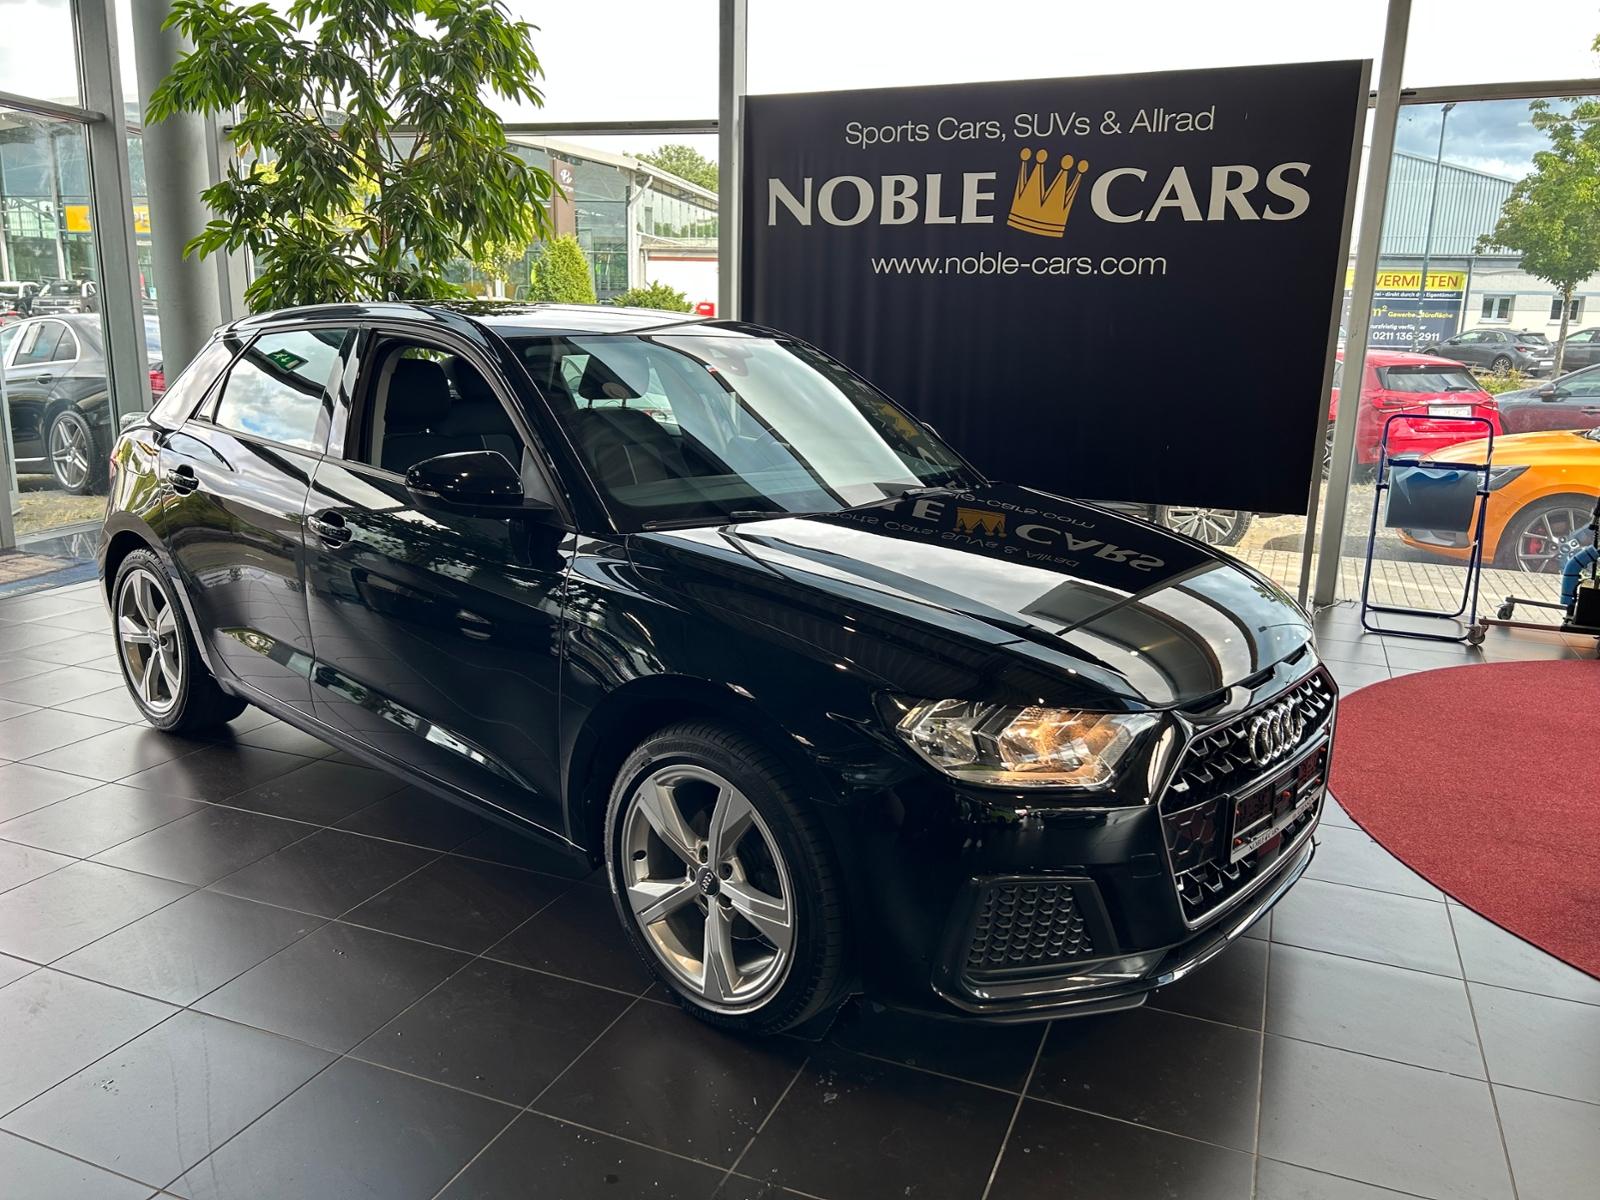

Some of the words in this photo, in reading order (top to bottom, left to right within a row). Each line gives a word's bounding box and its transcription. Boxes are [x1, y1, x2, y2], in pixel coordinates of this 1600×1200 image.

[845, 120, 930, 149] Sports
[937, 116, 1006, 142] Cars,
[1013, 111, 1091, 138] SUVs
[1099, 110, 1123, 135] &
[1128, 104, 1216, 134] Allrad
[767, 171, 997, 227] NOBLE
[1090, 162, 1311, 224] CARS
[871, 251, 1167, 276] www.noble-cars.com
[1372, 331, 1394, 341] 0211
